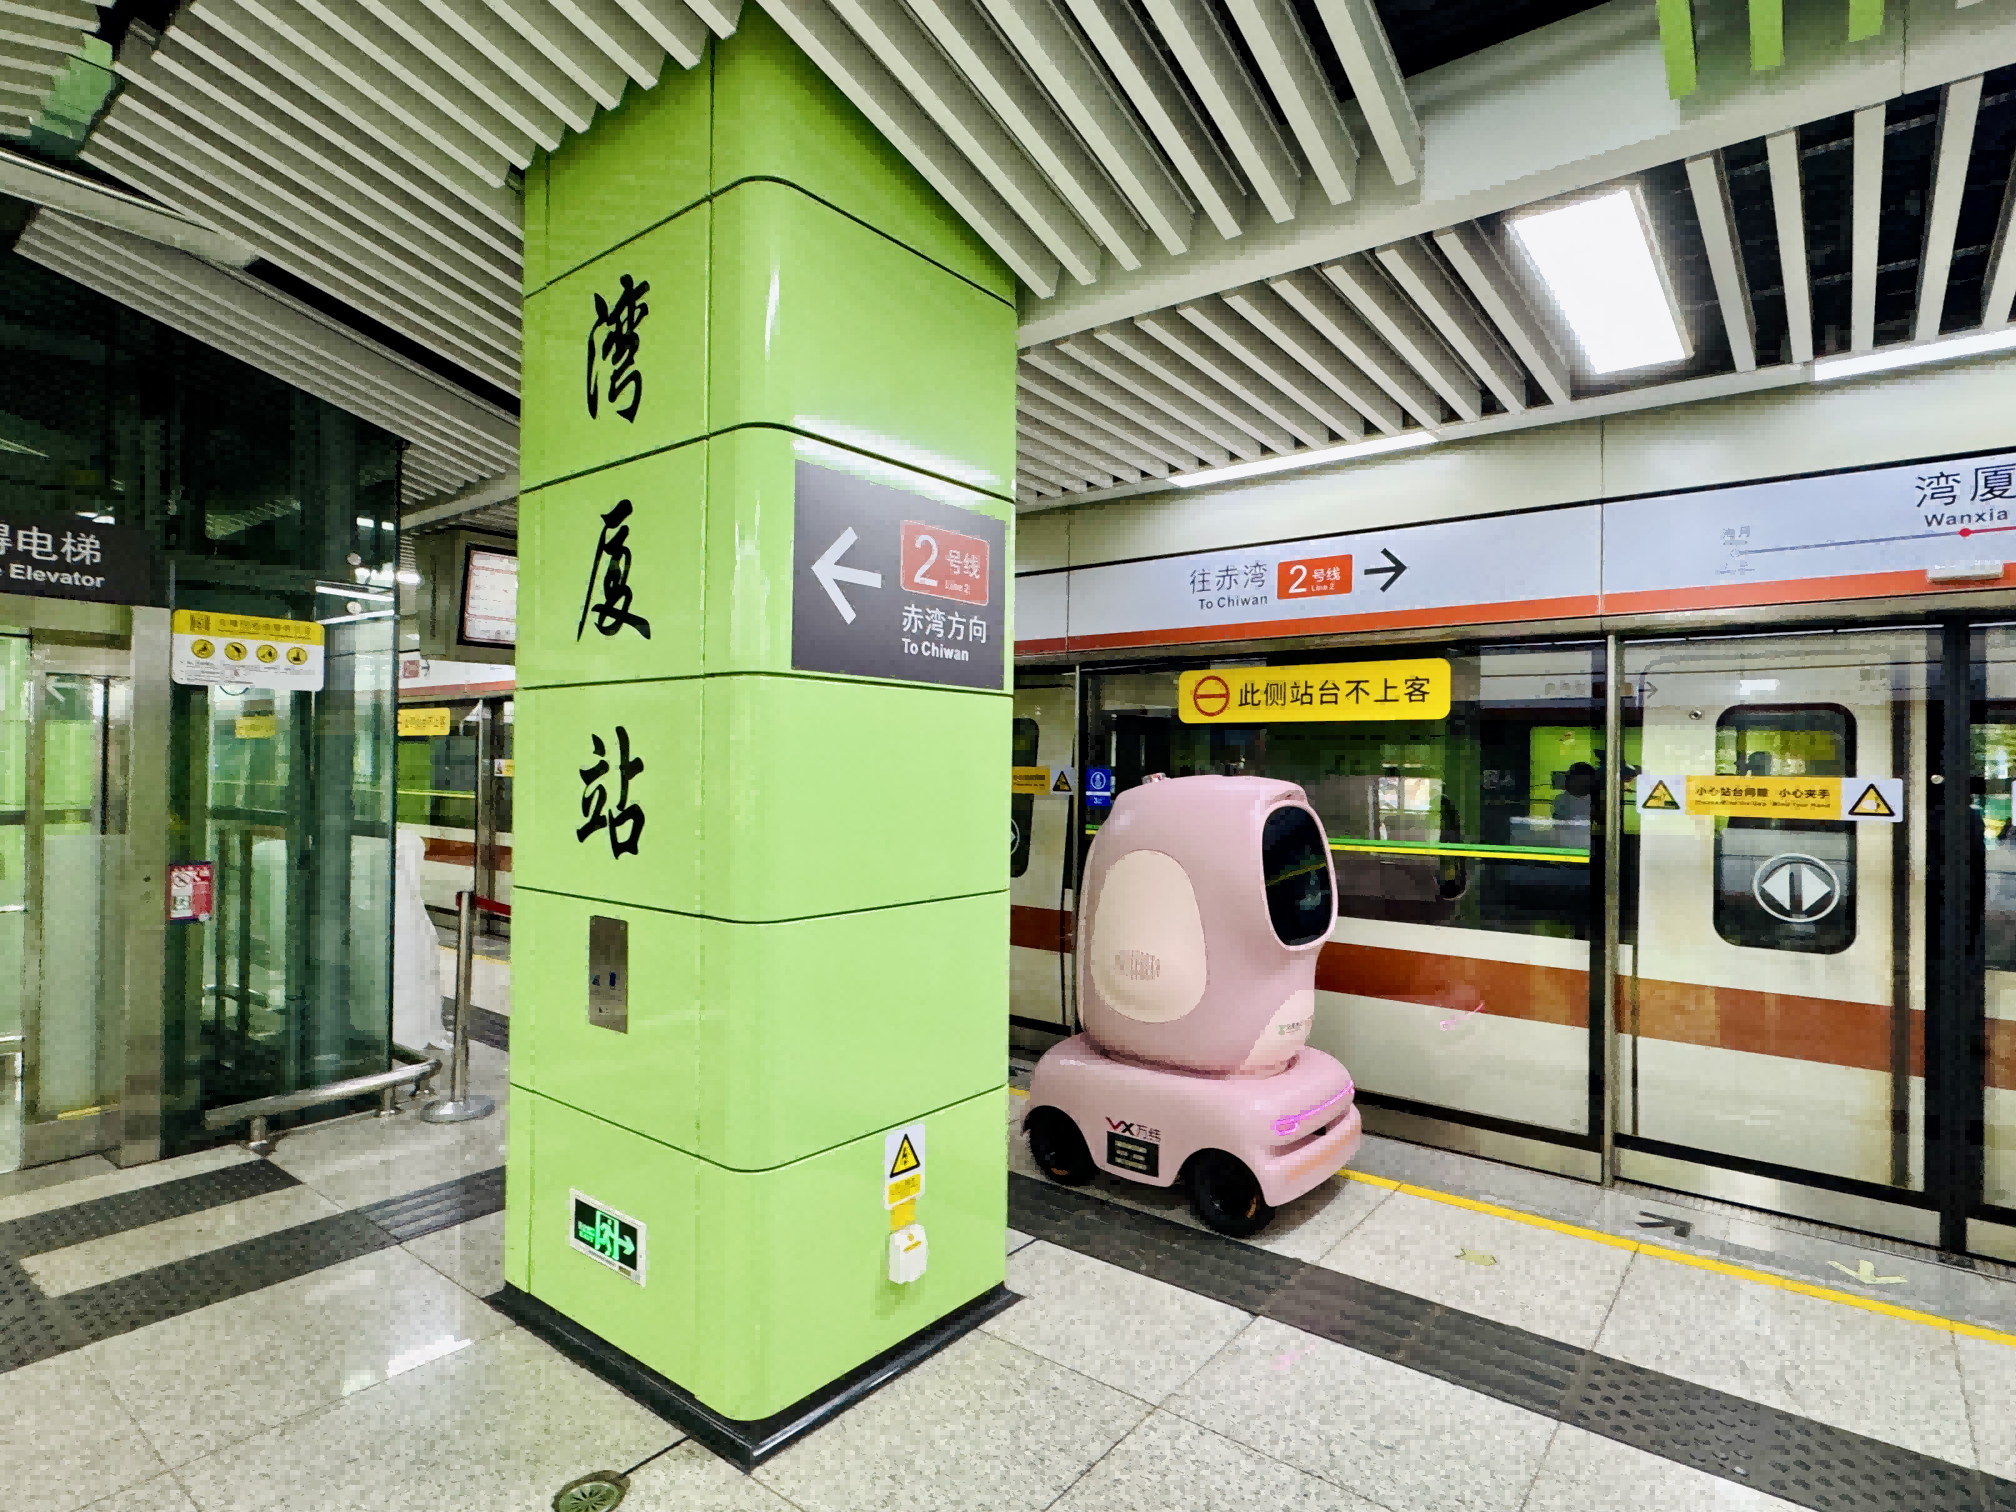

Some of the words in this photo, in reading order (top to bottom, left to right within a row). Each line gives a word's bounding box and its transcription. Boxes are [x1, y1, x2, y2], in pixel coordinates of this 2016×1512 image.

[1915, 463, 2016, 508] 湾厦
[1924, 508, 2008, 527] Wanxia
[9, 563, 105, 588] Elevator
[577, 273, 652, 860] 湾厦站
[1190, 562, 1267, 594] 往赤湾
[1199, 598, 1213, 610] To
[1217, 595, 1268, 608] Chiwan
[902, 603, 987, 644] 赤湾方向
[901, 638, 919, 655] To
[921, 641, 970, 661] Chiwan
[1238, 676, 1431, 708] 此侧站台不上客
